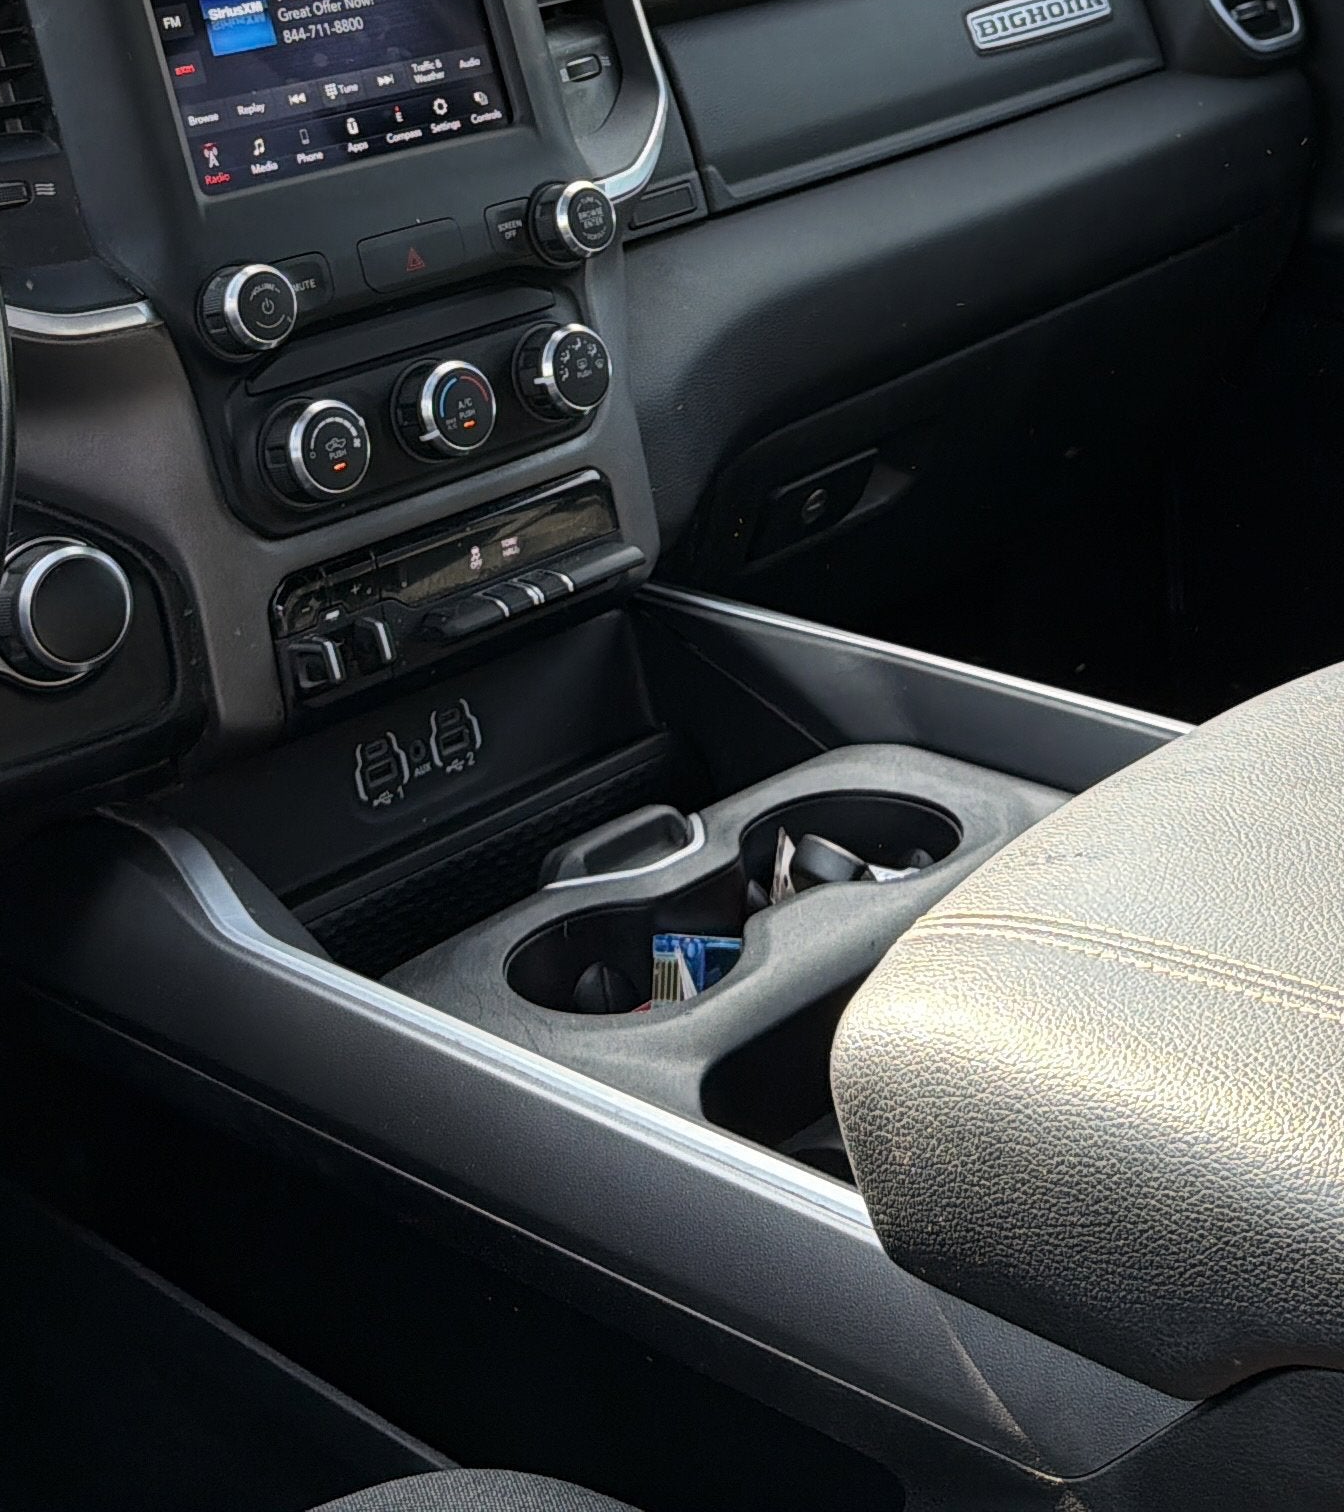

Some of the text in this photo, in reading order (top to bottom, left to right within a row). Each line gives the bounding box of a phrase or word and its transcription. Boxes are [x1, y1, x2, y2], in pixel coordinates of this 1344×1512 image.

[277, 6, 311, 22] Great
[313, 0, 342, 16] Offer
[162, 15, 182, 29] FM
[282, 16, 365, 45] 844-711-8800
[411, 59, 435, 73] Traffic
[459, 56, 481, 69] Audio
[413, 70, 445, 84] Weather
[337, 83, 359, 95] Tune
[236, 102, 266, 116] Replay
[470, 108, 503, 124] Controls
[187, 112, 219, 127] Browse
[430, 119, 462, 134] Settings
[386, 128, 423, 144] Compass
[347, 141, 369, 153] Apps
[296, 151, 324, 165] Phone
[250, 160, 279, 175] Media
[204, 171, 232, 186] Radio
[497, 219, 523, 233] SCREEN
[504, 229, 517, 240] OFF
[292, 278, 316, 293] MUTE
[458, 397, 473, 410] A/C
[466, 751, 476, 766] 2
[413, 761, 432, 778] AUX
[397, 785, 405, 800] 1
